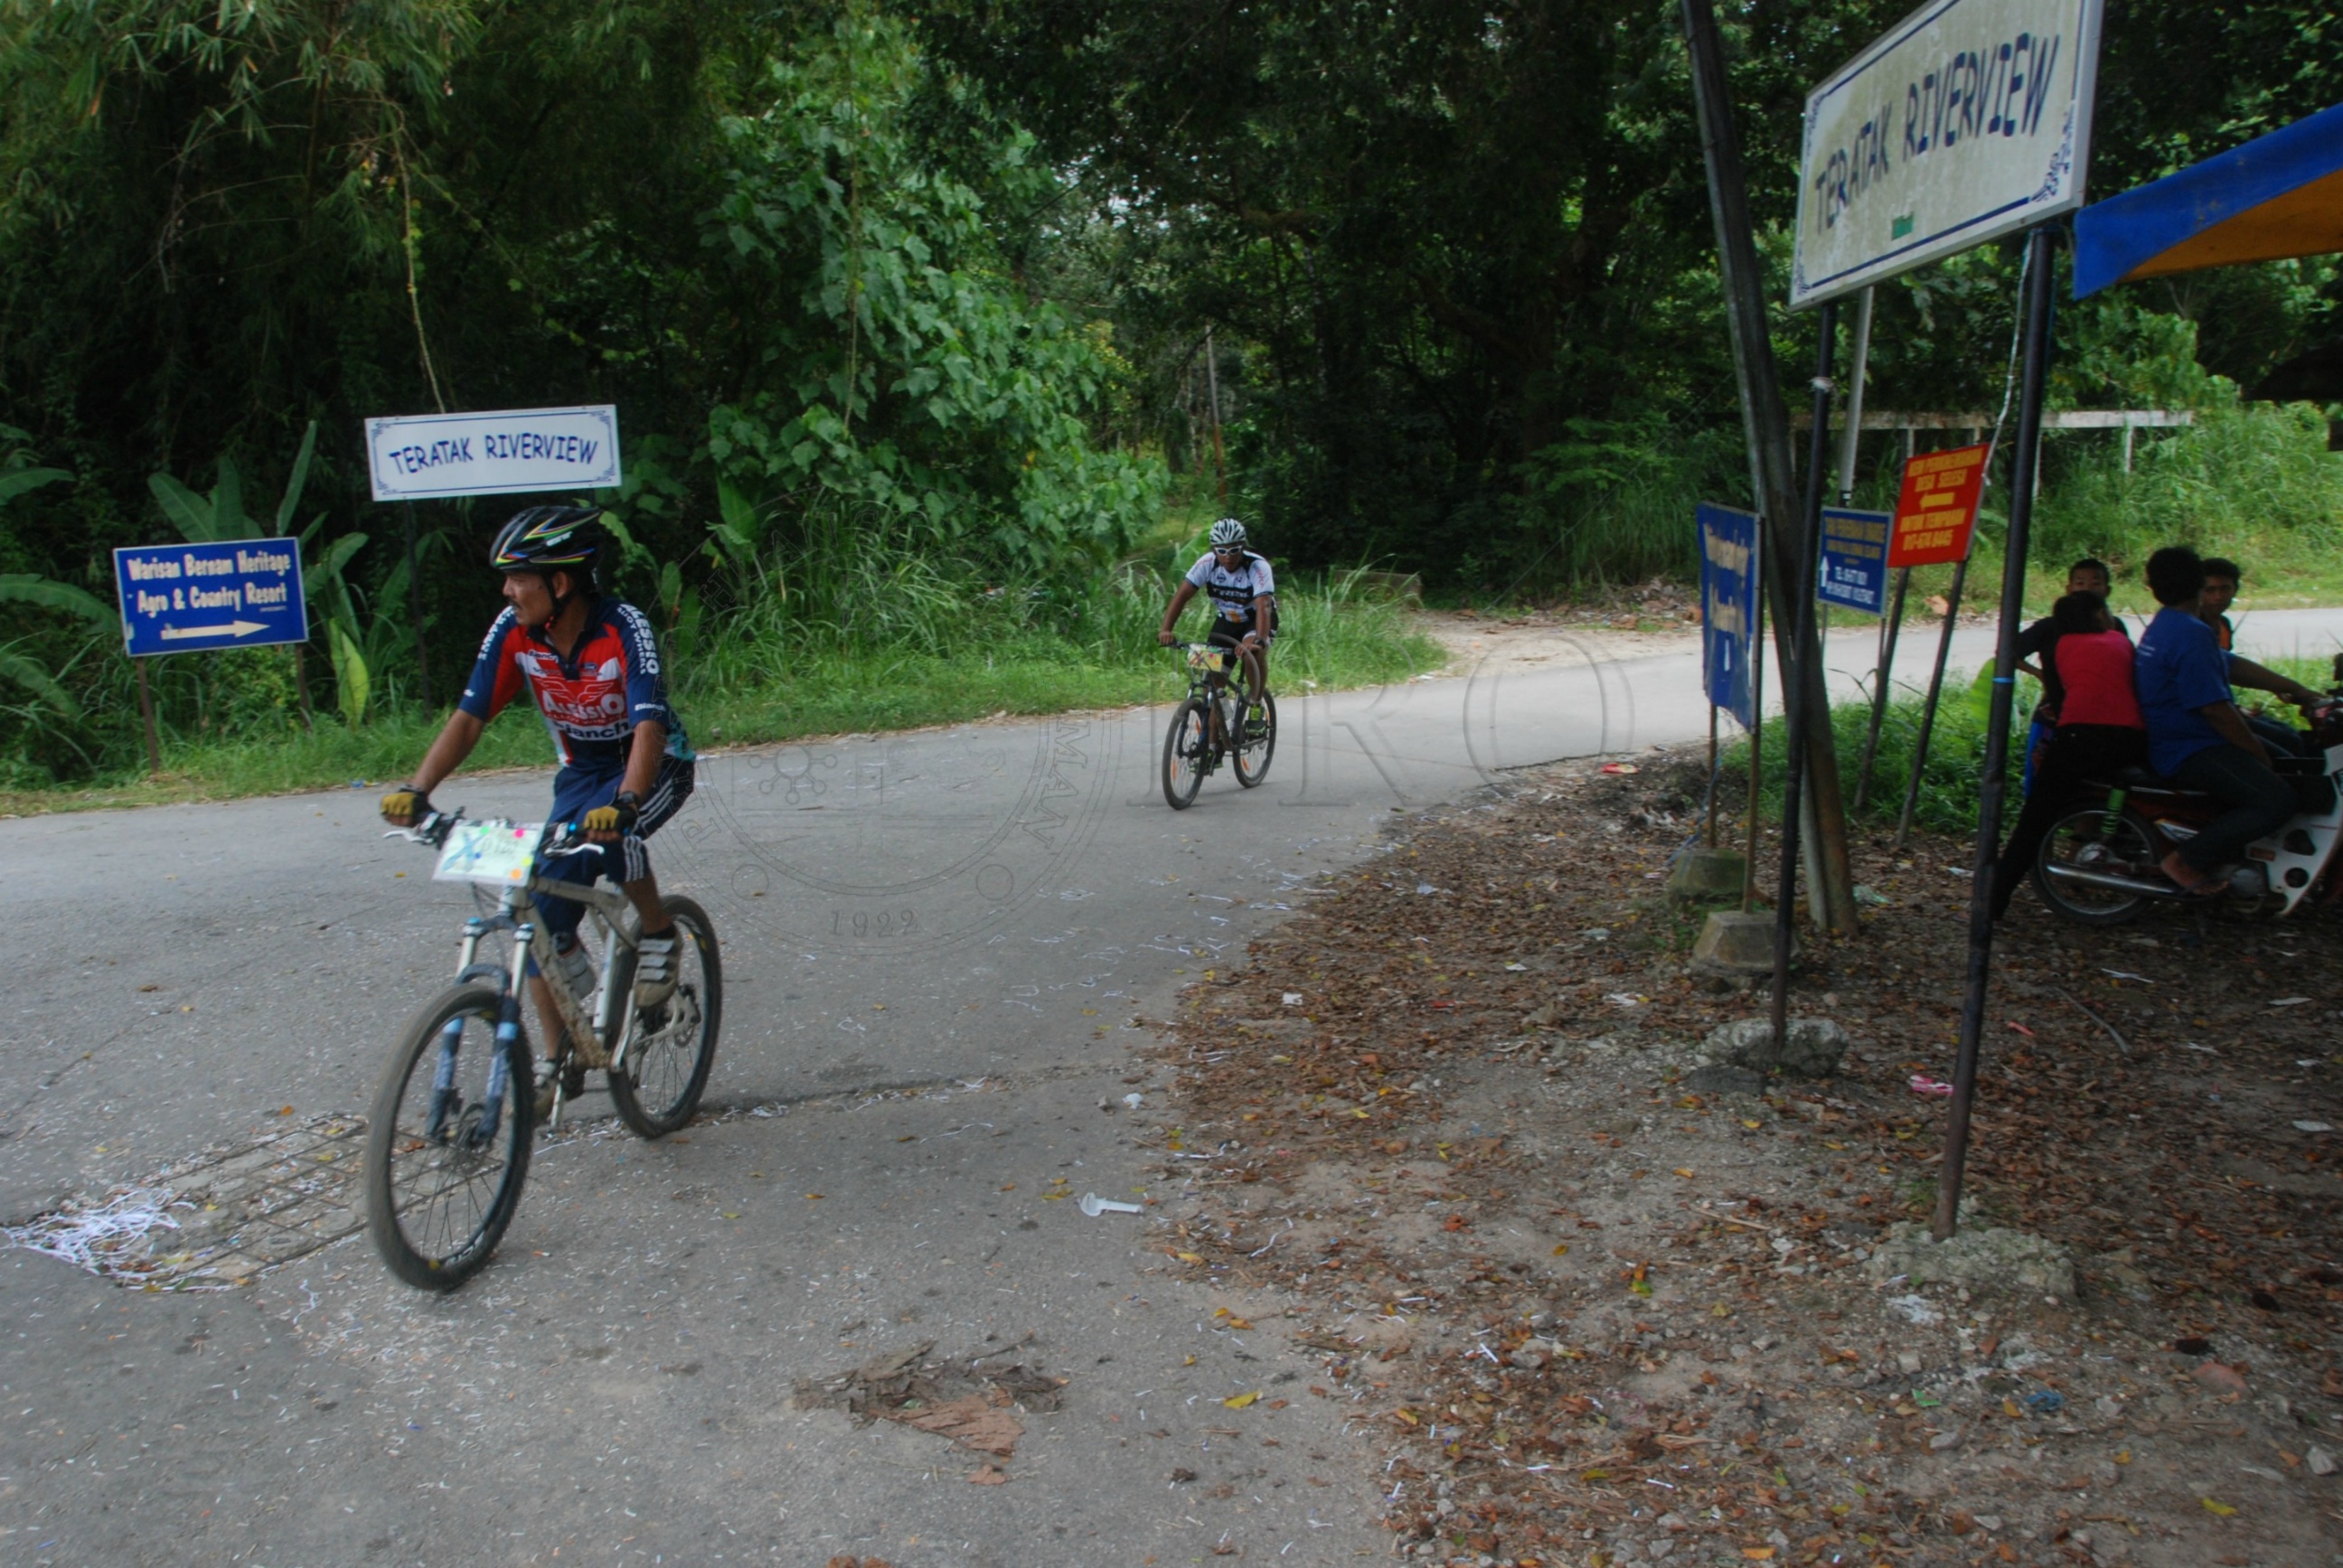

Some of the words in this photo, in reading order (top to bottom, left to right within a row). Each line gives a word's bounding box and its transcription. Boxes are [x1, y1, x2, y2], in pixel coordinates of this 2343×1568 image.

[1815, 100, 1893, 235] TERATAK
[1903, 33, 2060, 163] RIVERVIEW
[389, 437, 474, 474] TERATAK
[485, 432, 598, 465] RIVERVIEW
[127, 557, 181, 580] Warisan
[183, 553, 234, 577] Bernam
[237, 549, 291, 577] Heritage
[137, 589, 169, 618] Agro
[173, 588, 185, 610] &
[189, 586, 241, 612] Country
[245, 582, 287, 604] Resort
[618, 603, 660, 674] ALESSIO
[541, 690, 626, 719] ALESSIO
